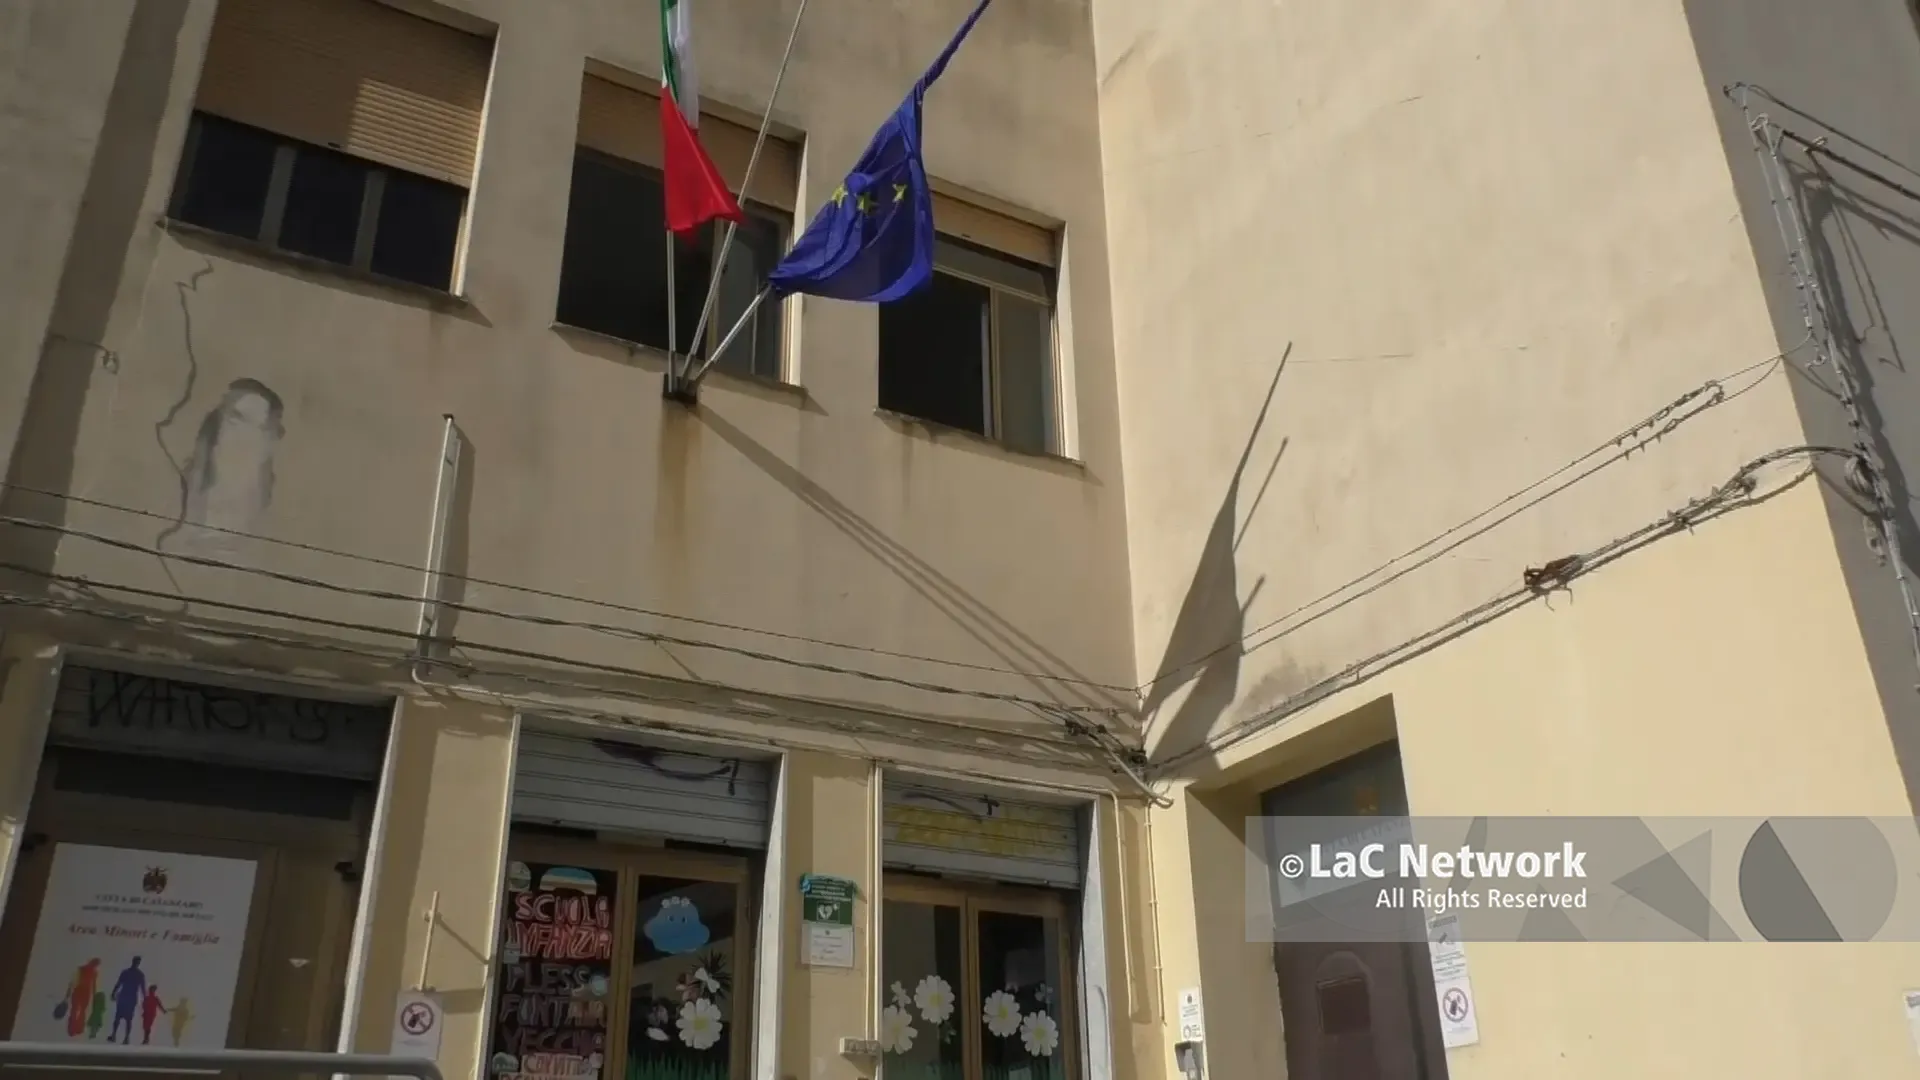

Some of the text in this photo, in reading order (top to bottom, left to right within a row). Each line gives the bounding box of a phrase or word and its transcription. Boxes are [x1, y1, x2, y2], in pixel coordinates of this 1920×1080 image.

[68, 923, 97, 935] Area
[162, 929, 221, 946] Famiglia
[507, 963, 609, 996] PLESS
